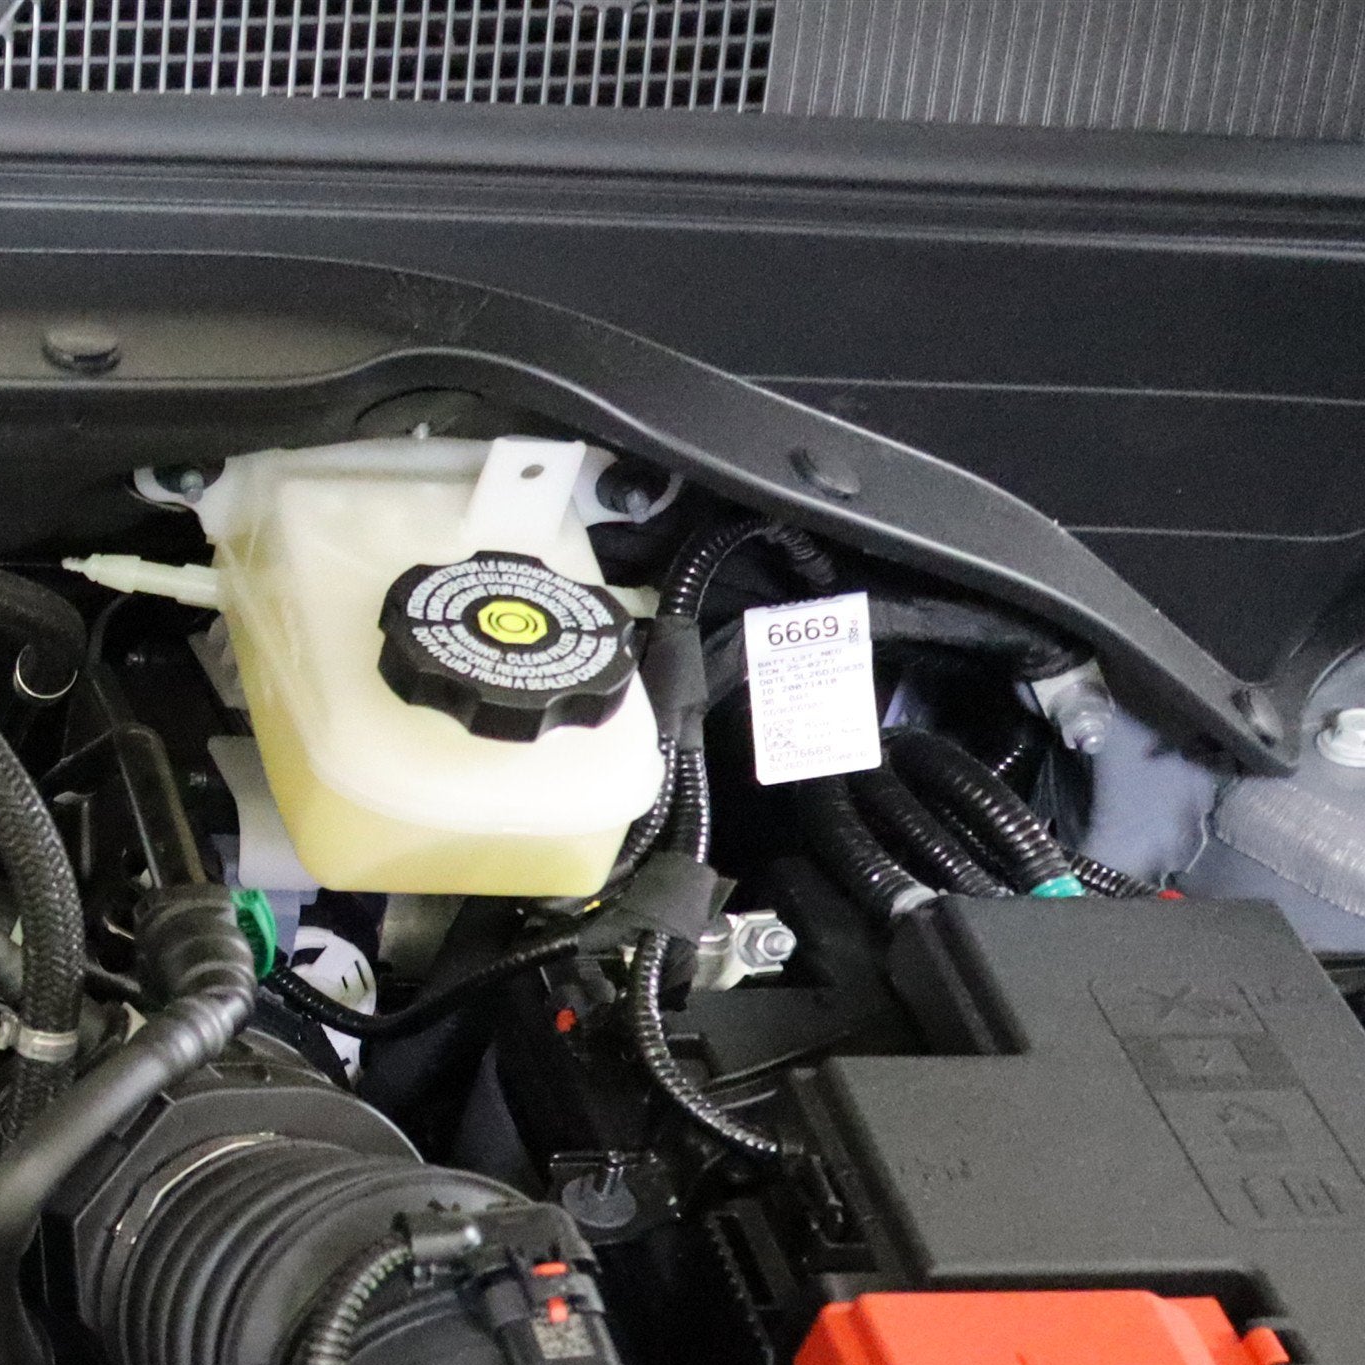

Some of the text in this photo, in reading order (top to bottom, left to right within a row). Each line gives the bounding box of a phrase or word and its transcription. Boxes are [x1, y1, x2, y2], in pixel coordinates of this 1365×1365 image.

[480, 560, 496, 572] LE
[497, 561, 553, 582] BOUCHON
[768, 615, 839, 646] 6669
[433, 648, 471, 673] FLUID
[470, 667, 512, 687] FROM
